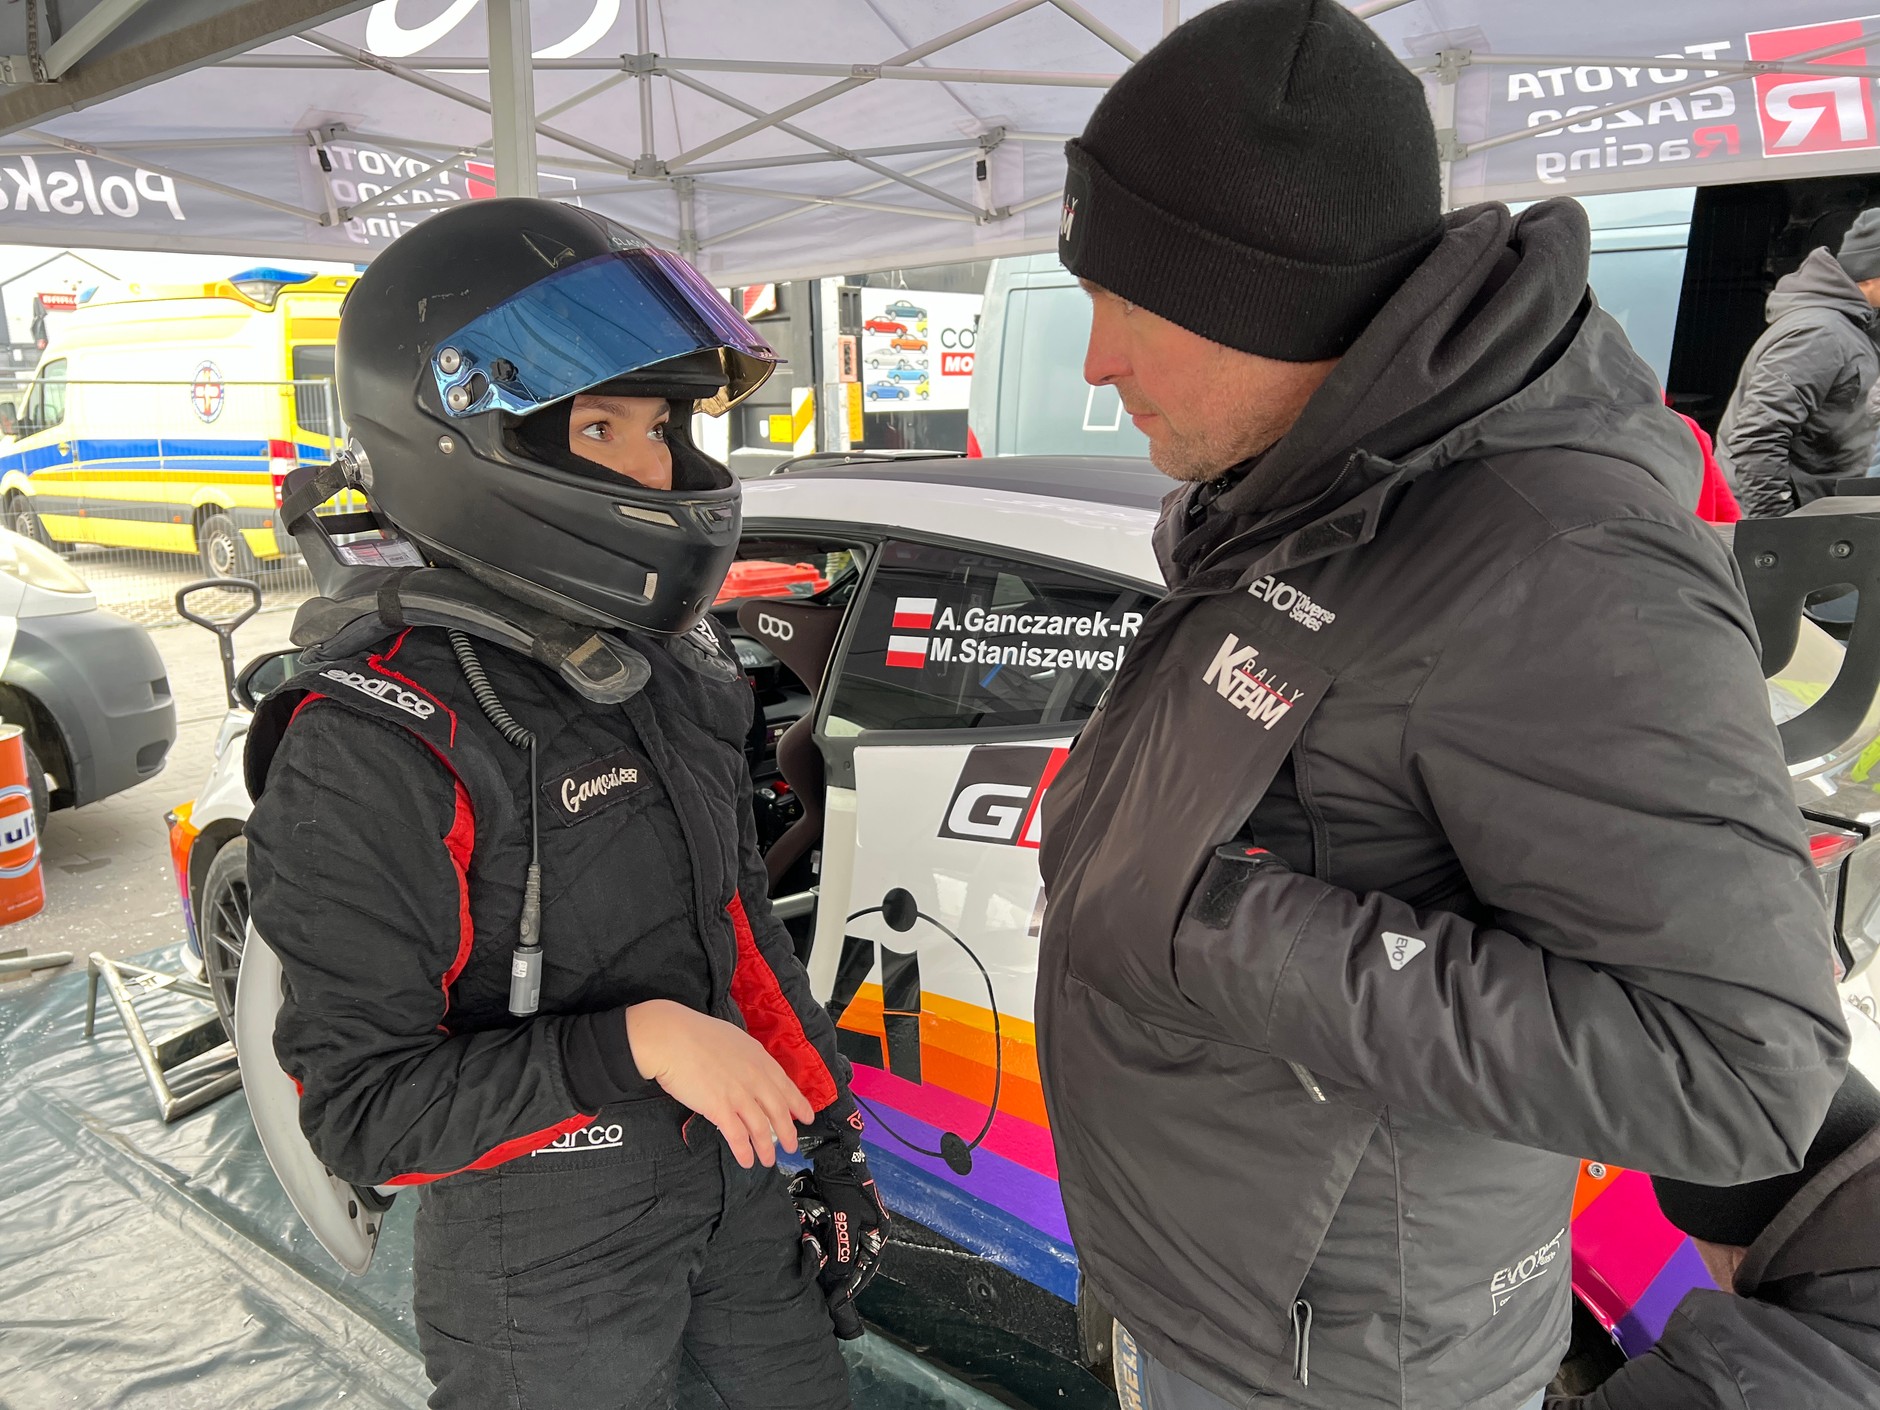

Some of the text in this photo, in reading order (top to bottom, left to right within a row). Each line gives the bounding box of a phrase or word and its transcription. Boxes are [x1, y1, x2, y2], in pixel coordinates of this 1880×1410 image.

[1247, 574, 1297, 612] EVO
[935, 607, 1144, 638] A.Ganczarek-R
[321, 668, 436, 720] sparco
[1228, 668, 1292, 731] TEAM
[1243, 658, 1305, 703] RALLY
[0, 813, 35, 846] ulf
[1392, 937, 1408, 962] EVO
[834, 1211, 851, 1264] sparco
[1491, 1254, 1537, 1293] EVO
